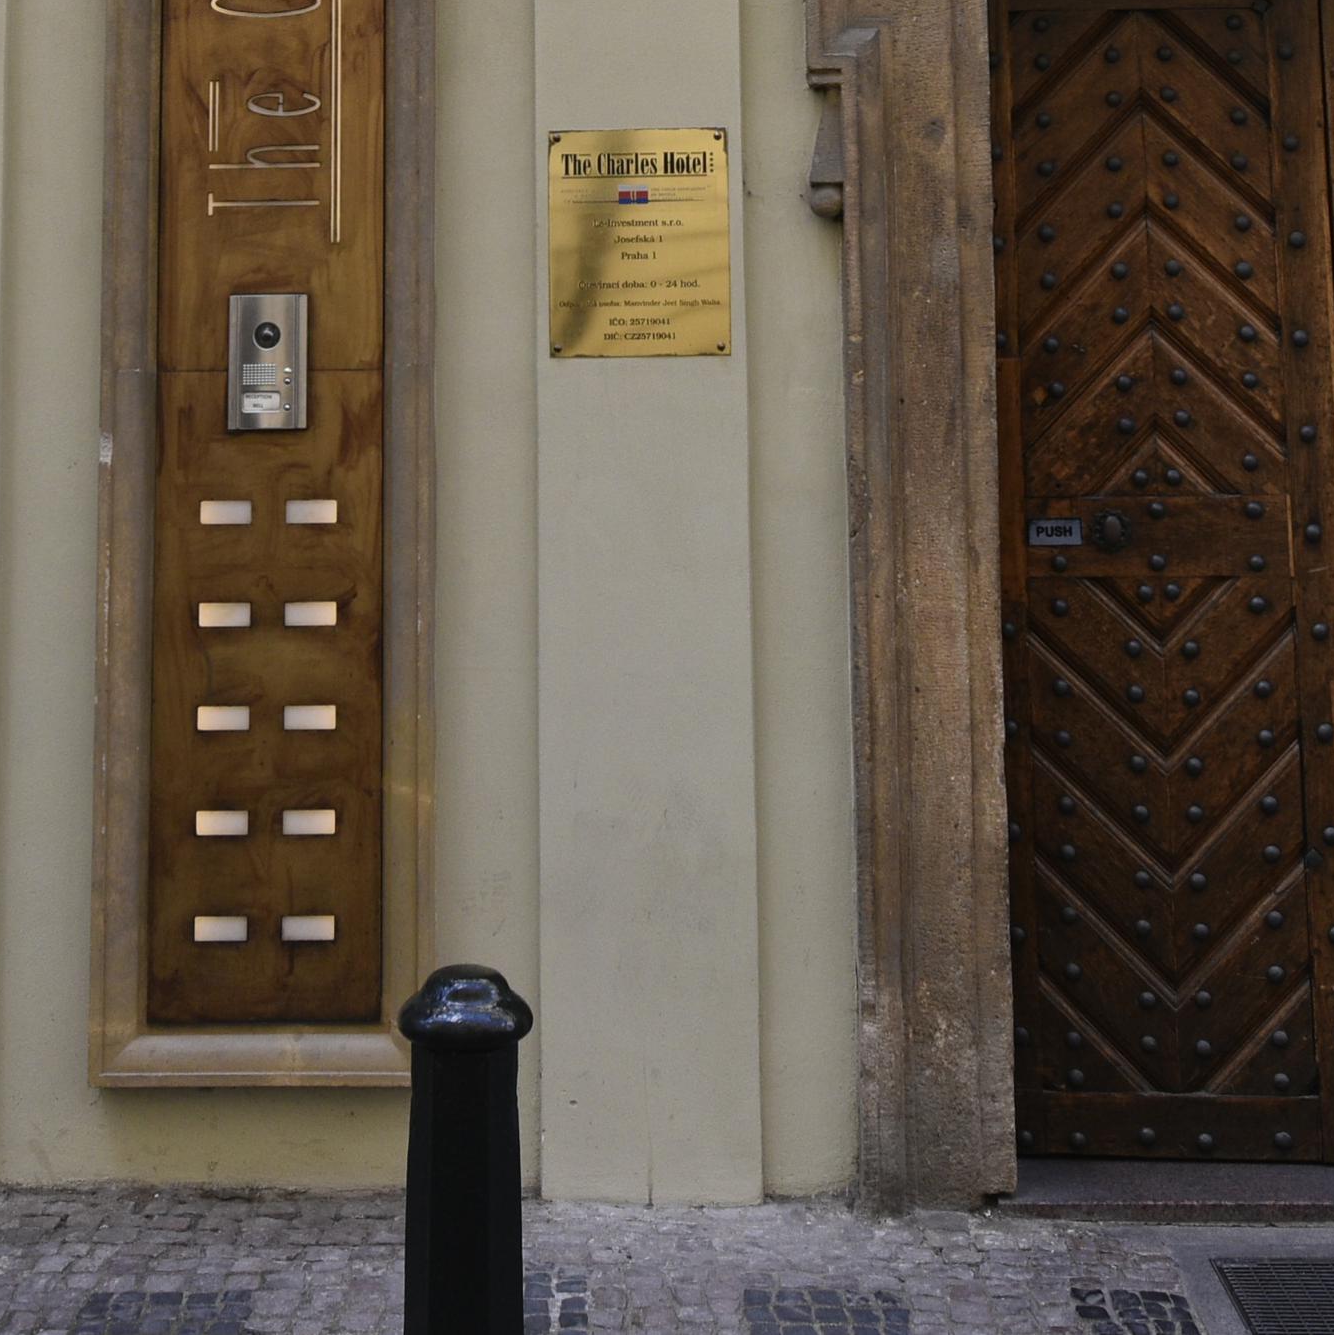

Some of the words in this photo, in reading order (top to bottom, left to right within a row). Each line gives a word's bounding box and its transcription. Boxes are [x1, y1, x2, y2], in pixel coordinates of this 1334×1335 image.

[207, 92, 322, 217] The
[561, 153, 592, 176] The
[597, 152, 658, 176] Charles
[663, 151, 707, 174] Hotel
[661, 219, 684, 228] s.r.o.
[614, 235, 655, 244] Josefská
[658, 235, 663, 243] 1
[621, 251, 649, 260] Praha
[652, 251, 657, 259] 1
[622, 280, 647, 289] doba:
[650, 280, 657, 288] 0
[665, 280, 678, 288] 24
[680, 280, 700, 288] hod.
[1036, 525, 1073, 538] PUSH
